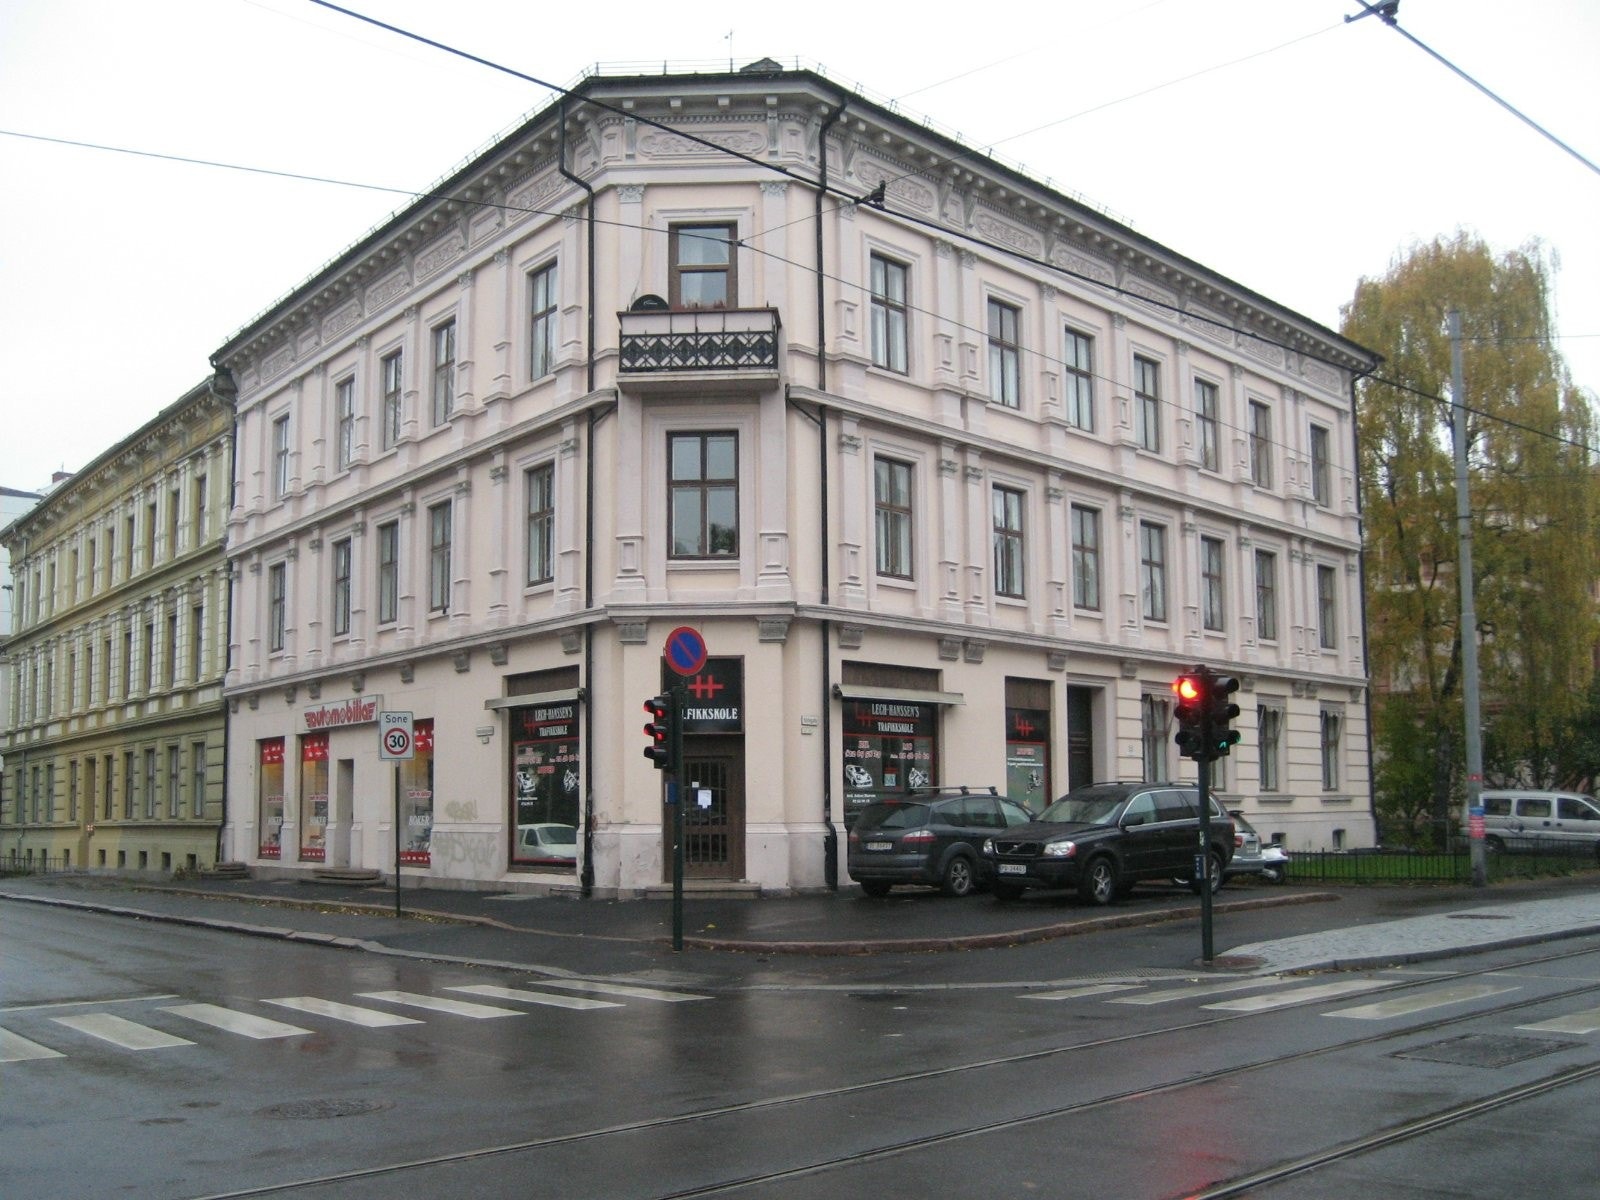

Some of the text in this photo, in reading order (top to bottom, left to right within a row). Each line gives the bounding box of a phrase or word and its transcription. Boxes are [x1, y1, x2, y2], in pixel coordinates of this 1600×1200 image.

[385, 714, 408, 724] Sone
[682, 708, 738, 720] FIKKSKOLE
[389, 734, 406, 749] 30
